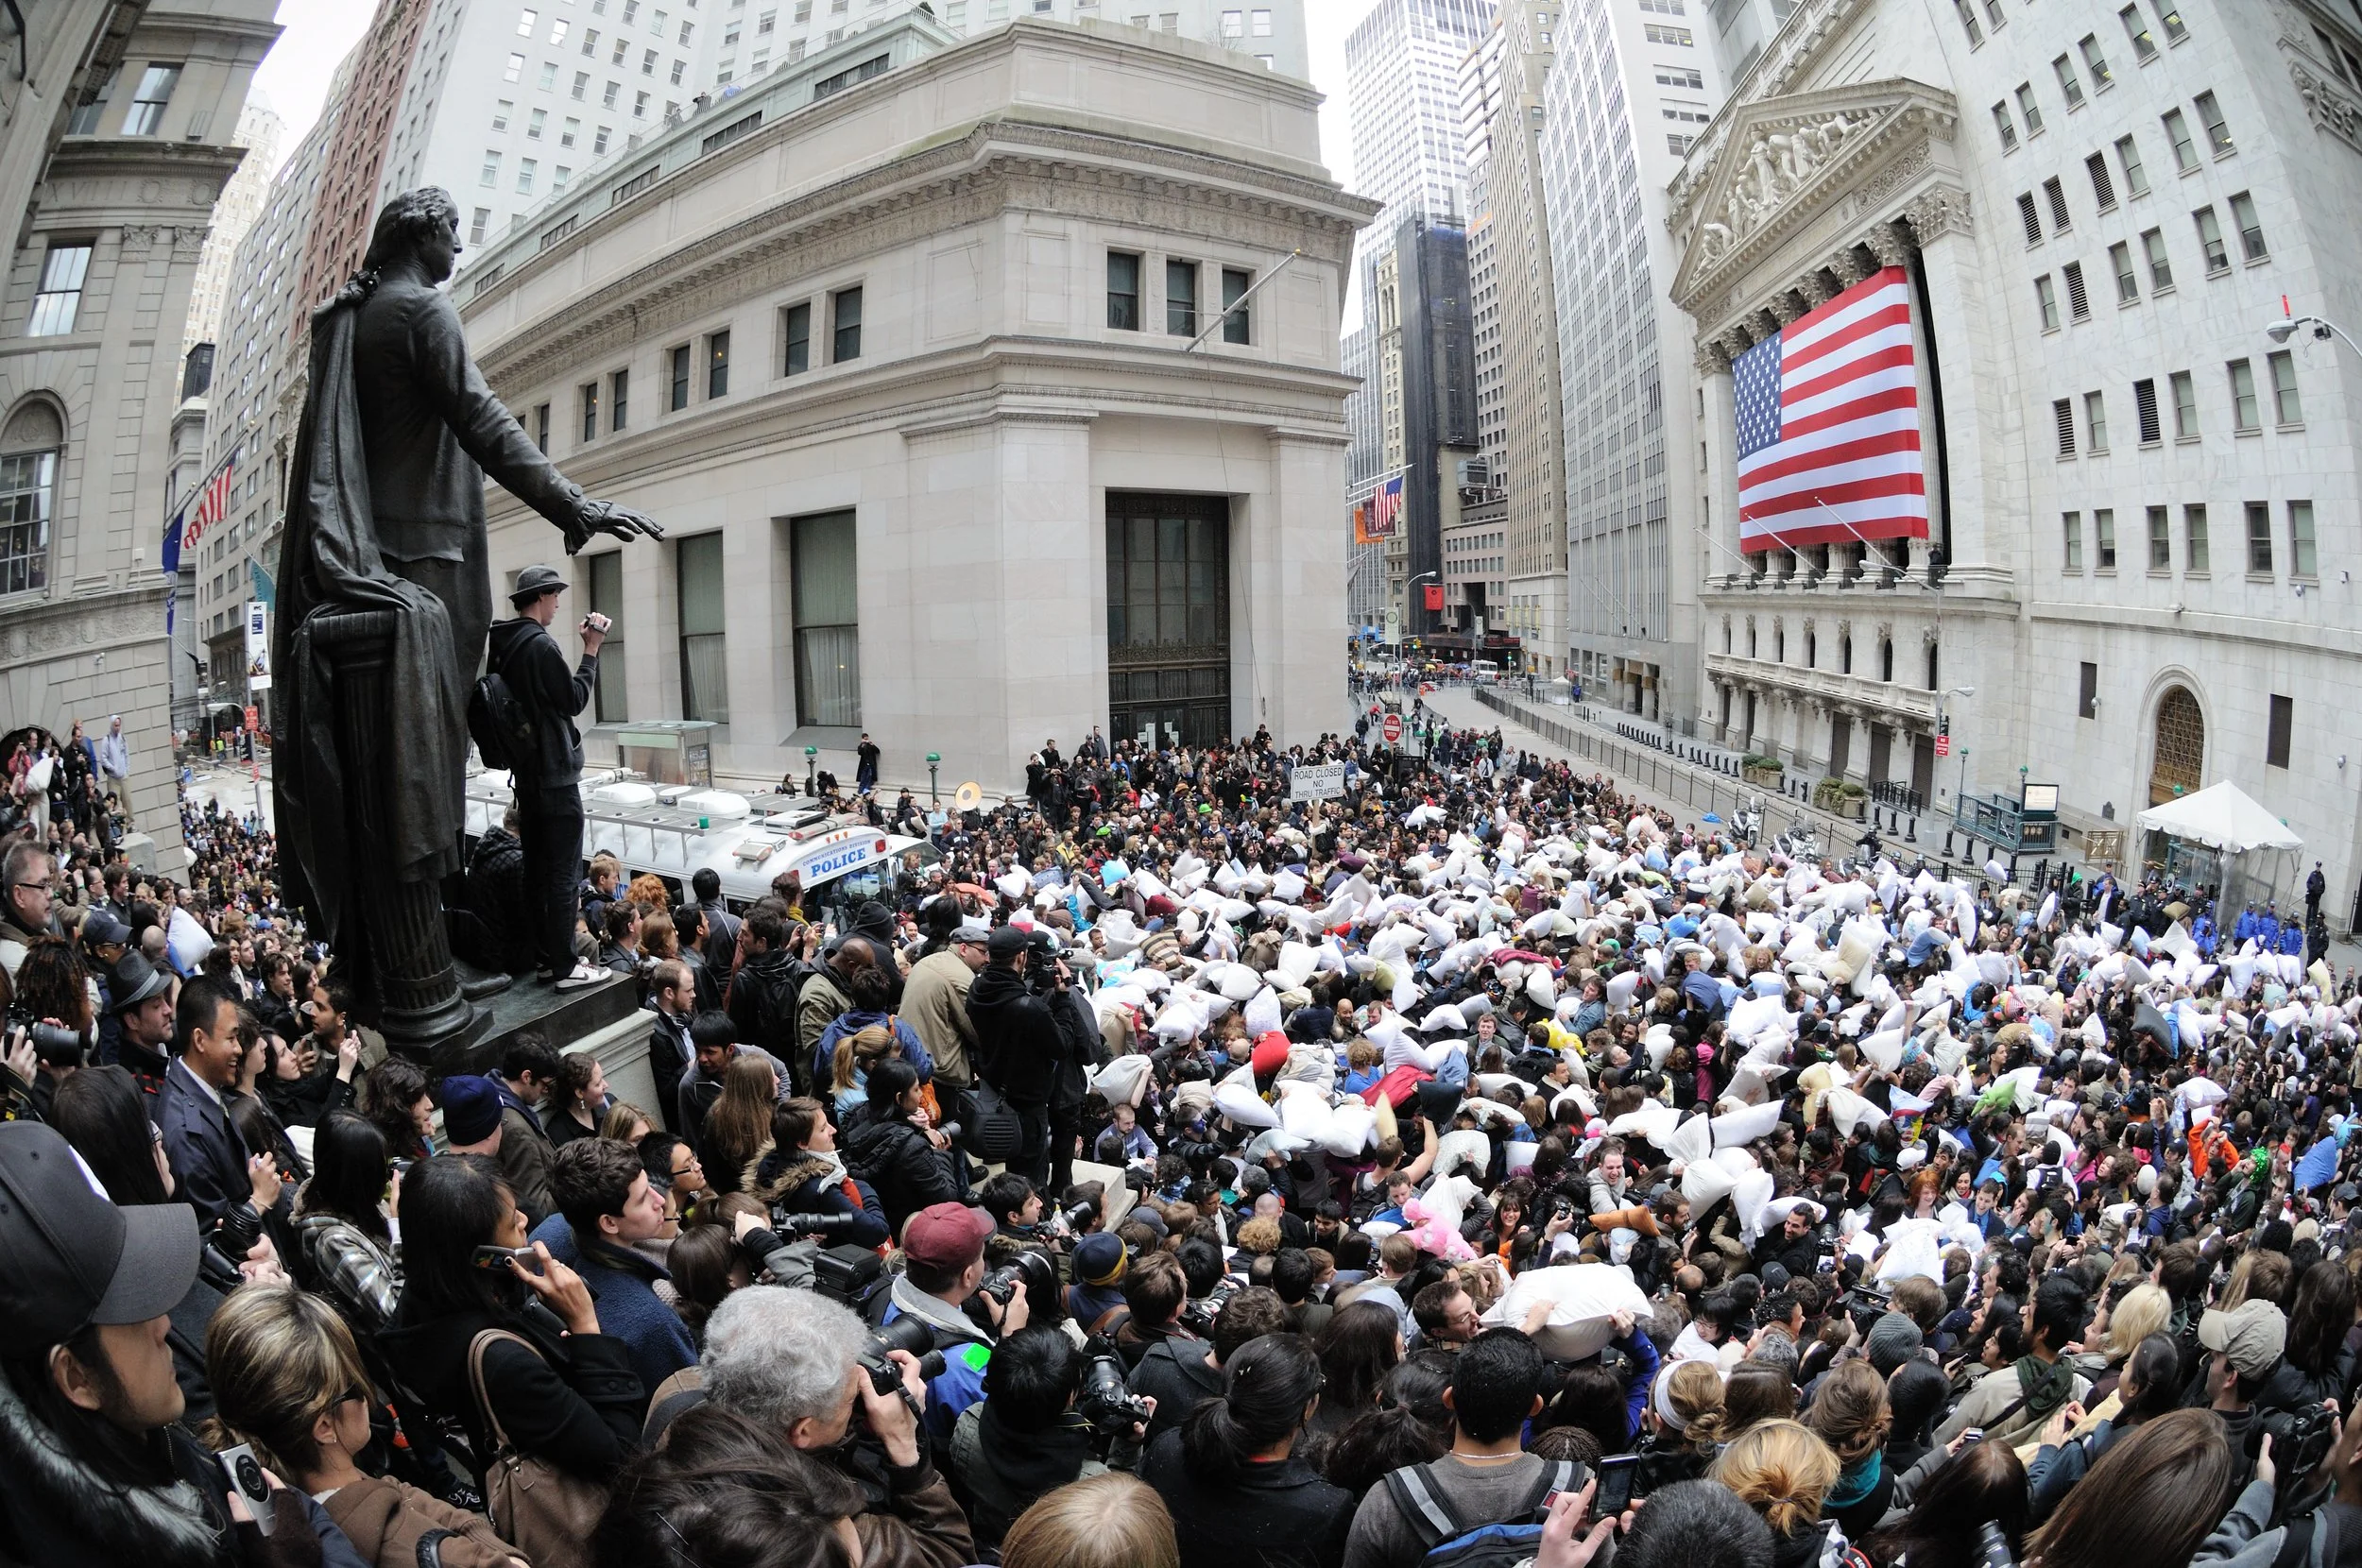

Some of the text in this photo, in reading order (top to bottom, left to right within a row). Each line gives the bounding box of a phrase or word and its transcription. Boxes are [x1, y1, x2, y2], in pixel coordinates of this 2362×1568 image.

[1294, 767, 1342, 780] ROAD CLOSED
[1313, 779, 1324, 788] NO
[1295, 787, 1341, 798] THRU TRAFFIC
[802, 840, 871, 866] COMMUNICATIONS DIVISION
[811, 848, 866, 878] POLICE
